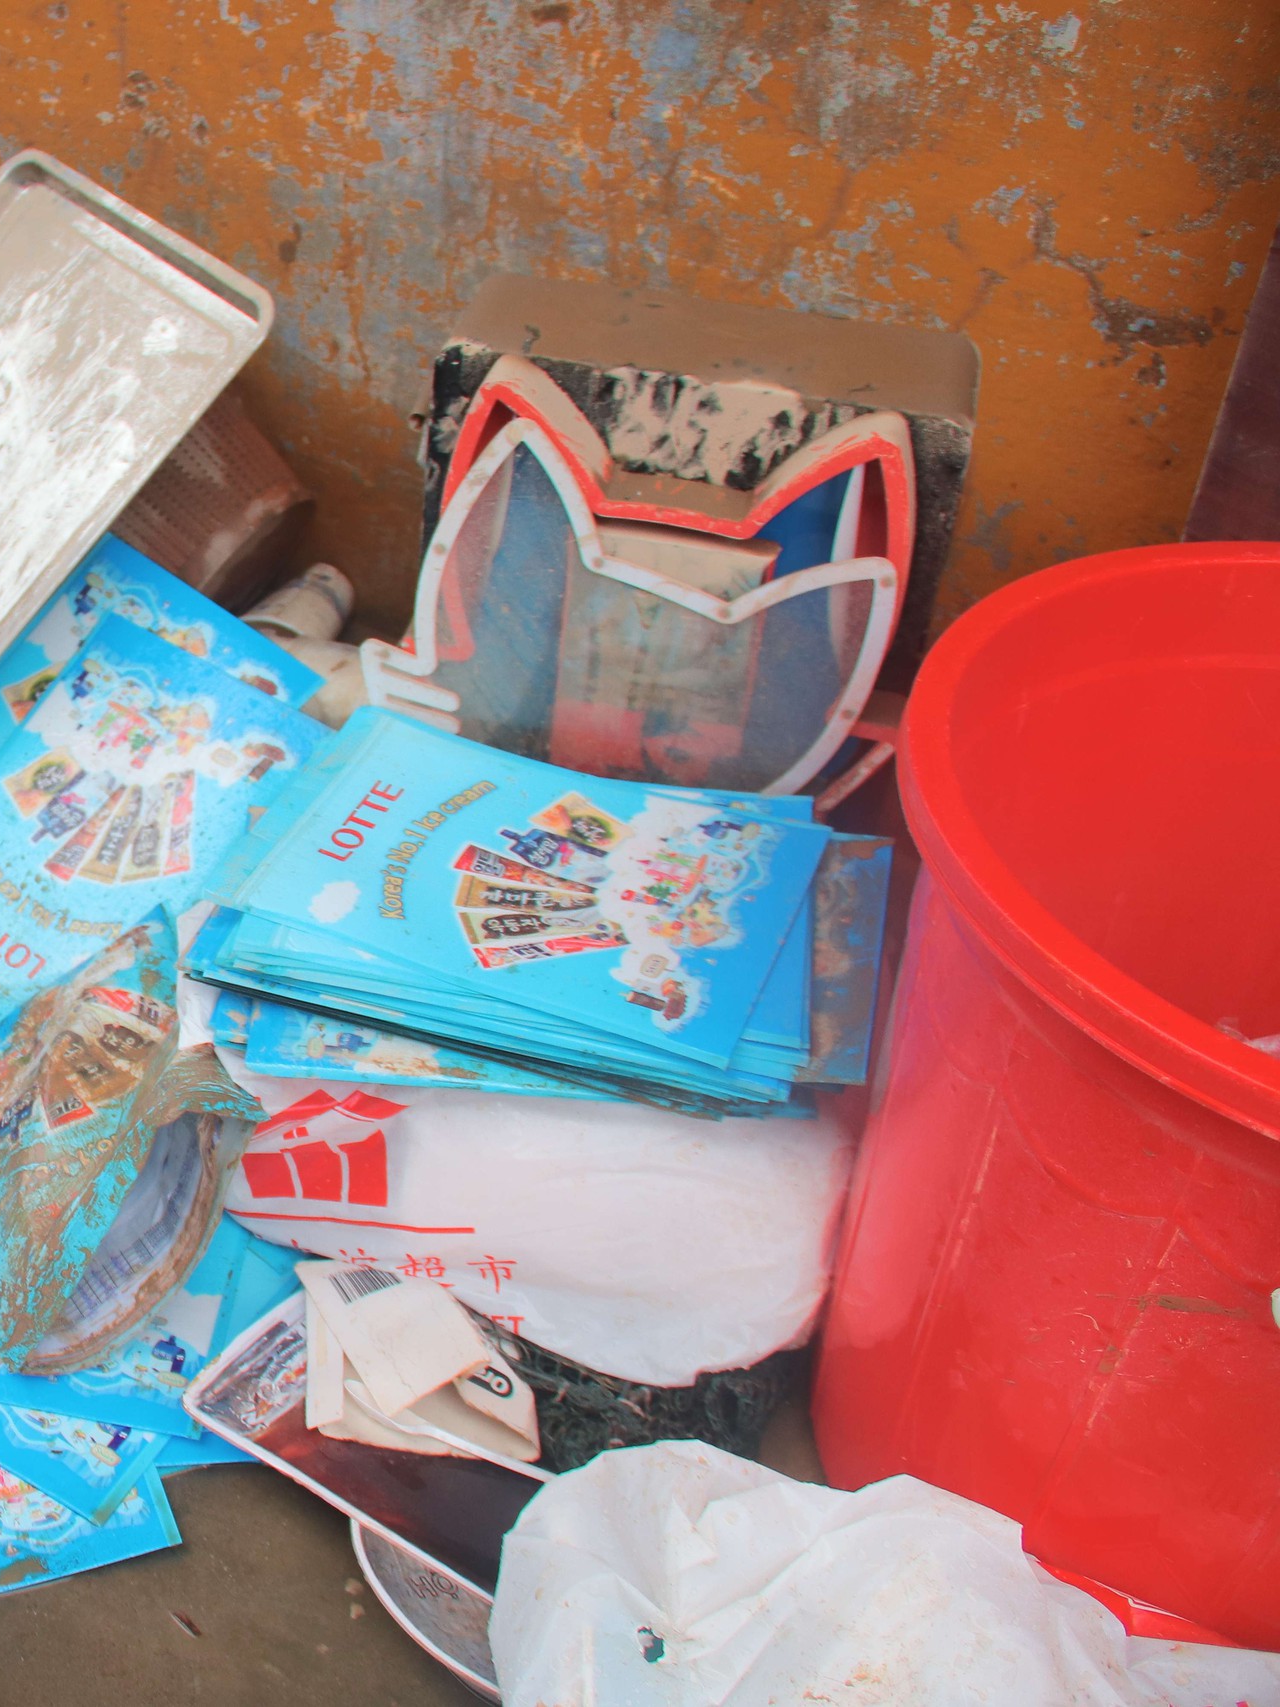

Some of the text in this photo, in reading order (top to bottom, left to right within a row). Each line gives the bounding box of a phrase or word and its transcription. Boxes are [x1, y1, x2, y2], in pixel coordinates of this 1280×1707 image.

[317, 780, 405, 862] LOTTE
[377, 779, 498, 920] Korea's No.1 Ice cream
